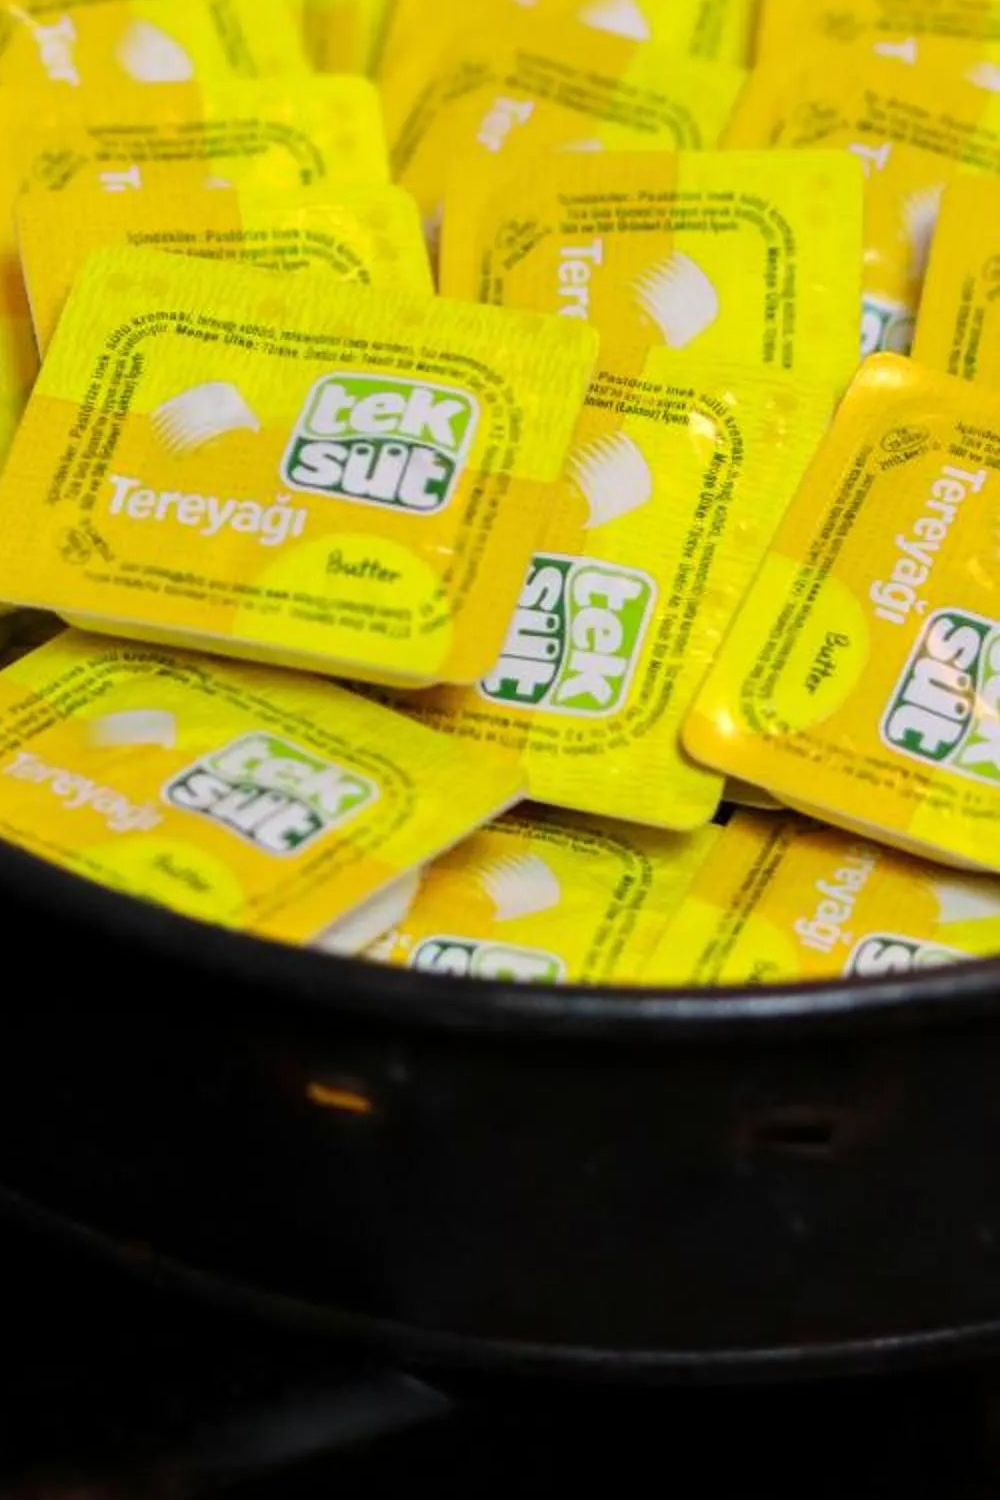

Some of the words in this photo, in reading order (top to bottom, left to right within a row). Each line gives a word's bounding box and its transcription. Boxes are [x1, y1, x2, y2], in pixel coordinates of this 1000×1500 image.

[311, 383, 464, 449] tek
[107, 475, 307, 546] Tereyağı
[294, 443, 456, 507] süt
[327, 550, 404, 585] Butter
[868, 464, 990, 625] Tereyağı
[485, 566, 562, 696] süt
[558, 572, 644, 705] tek
[804, 630, 851, 695] Butter
[888, 617, 982, 752] süt
[3, 750, 163, 833] Tereyağı
[176, 778, 320, 851] süt
[206, 741, 360, 817] tek
[794, 849, 877, 954] reyağı
